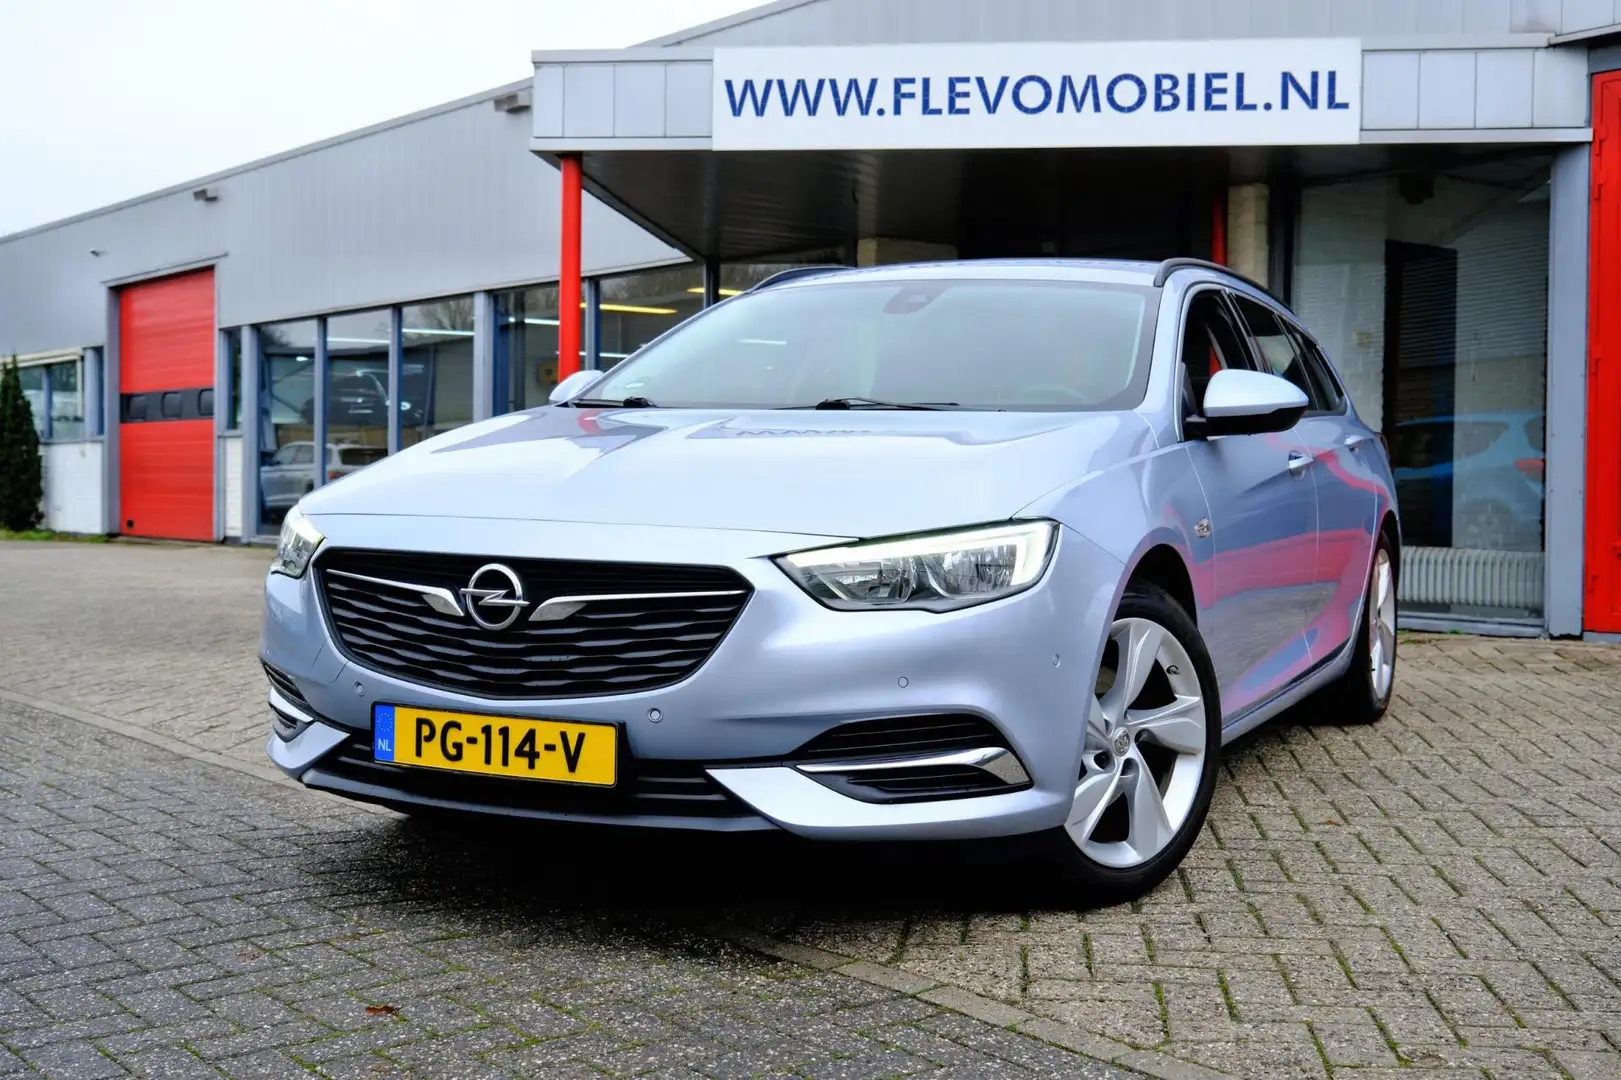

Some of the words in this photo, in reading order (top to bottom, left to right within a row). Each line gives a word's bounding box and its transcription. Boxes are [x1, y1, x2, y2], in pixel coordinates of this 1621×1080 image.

[724, 70, 1350, 117] WWW.FLEVOMOBIEL.NL
[377, 738, 392, 752] NL
[415, 717, 586, 774] PG-114-V
